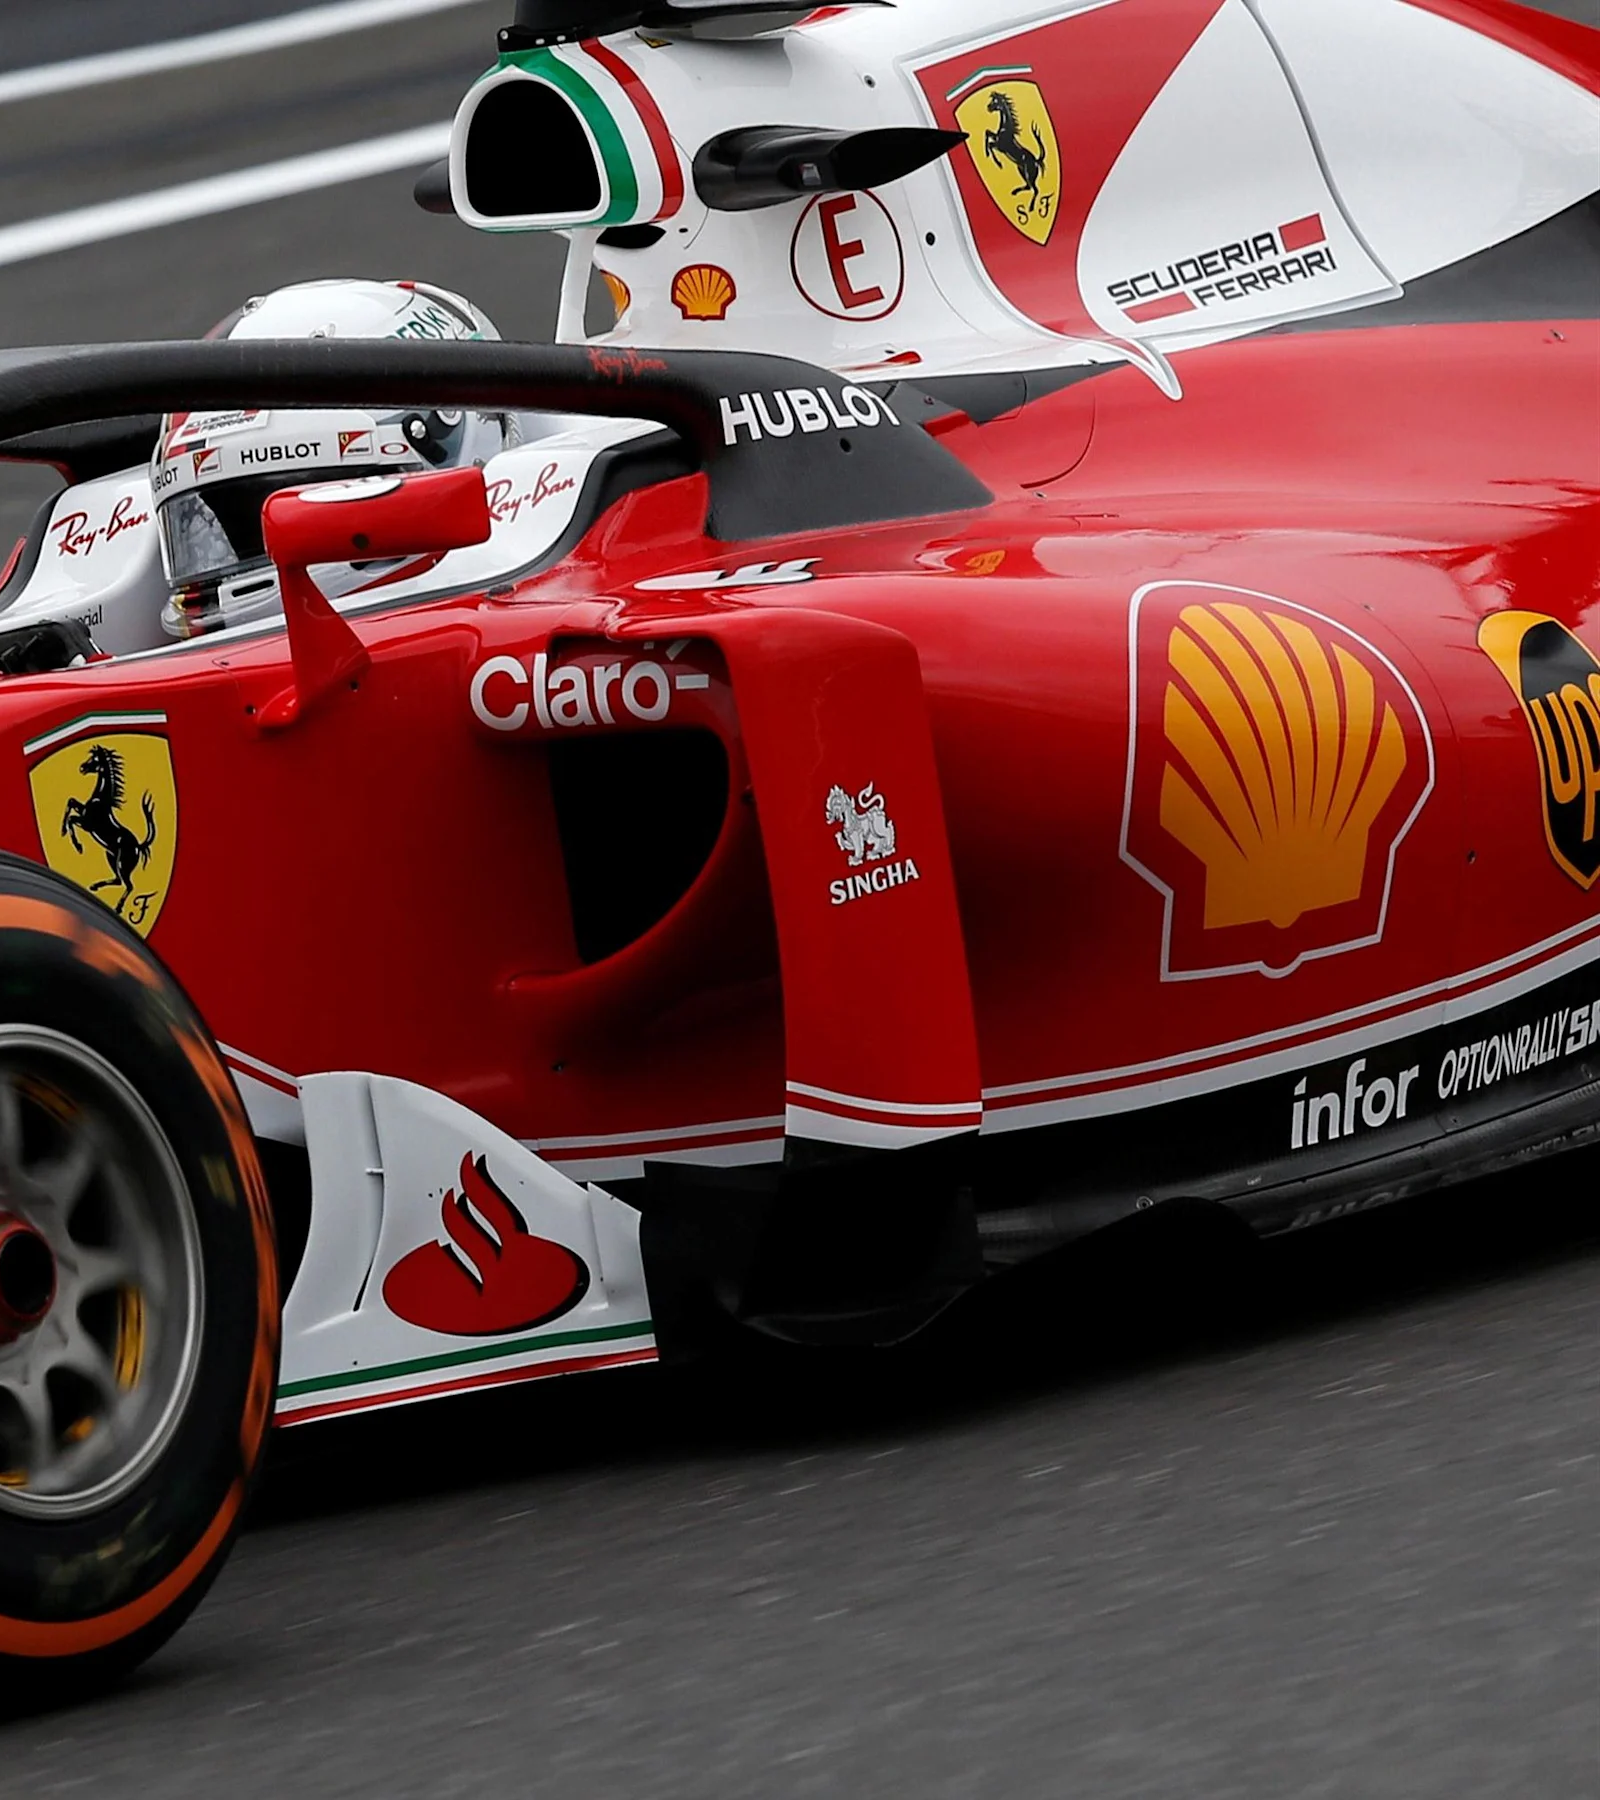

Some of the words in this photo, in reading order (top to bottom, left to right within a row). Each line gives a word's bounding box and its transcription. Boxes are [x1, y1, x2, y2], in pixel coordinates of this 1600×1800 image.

[817, 193, 886, 310] E
[1016, 204, 1029, 226] S
[1106, 231, 1280, 306] SCUDERIA
[1192, 246, 1338, 307] FERRARI
[240, 442, 322, 465] HUBLOT
[469, 652, 671, 731] Claro
[1529, 672, 1600, 842] up
[829, 858, 920, 906] SINGHA
[1290, 1058, 1419, 1150] infor
